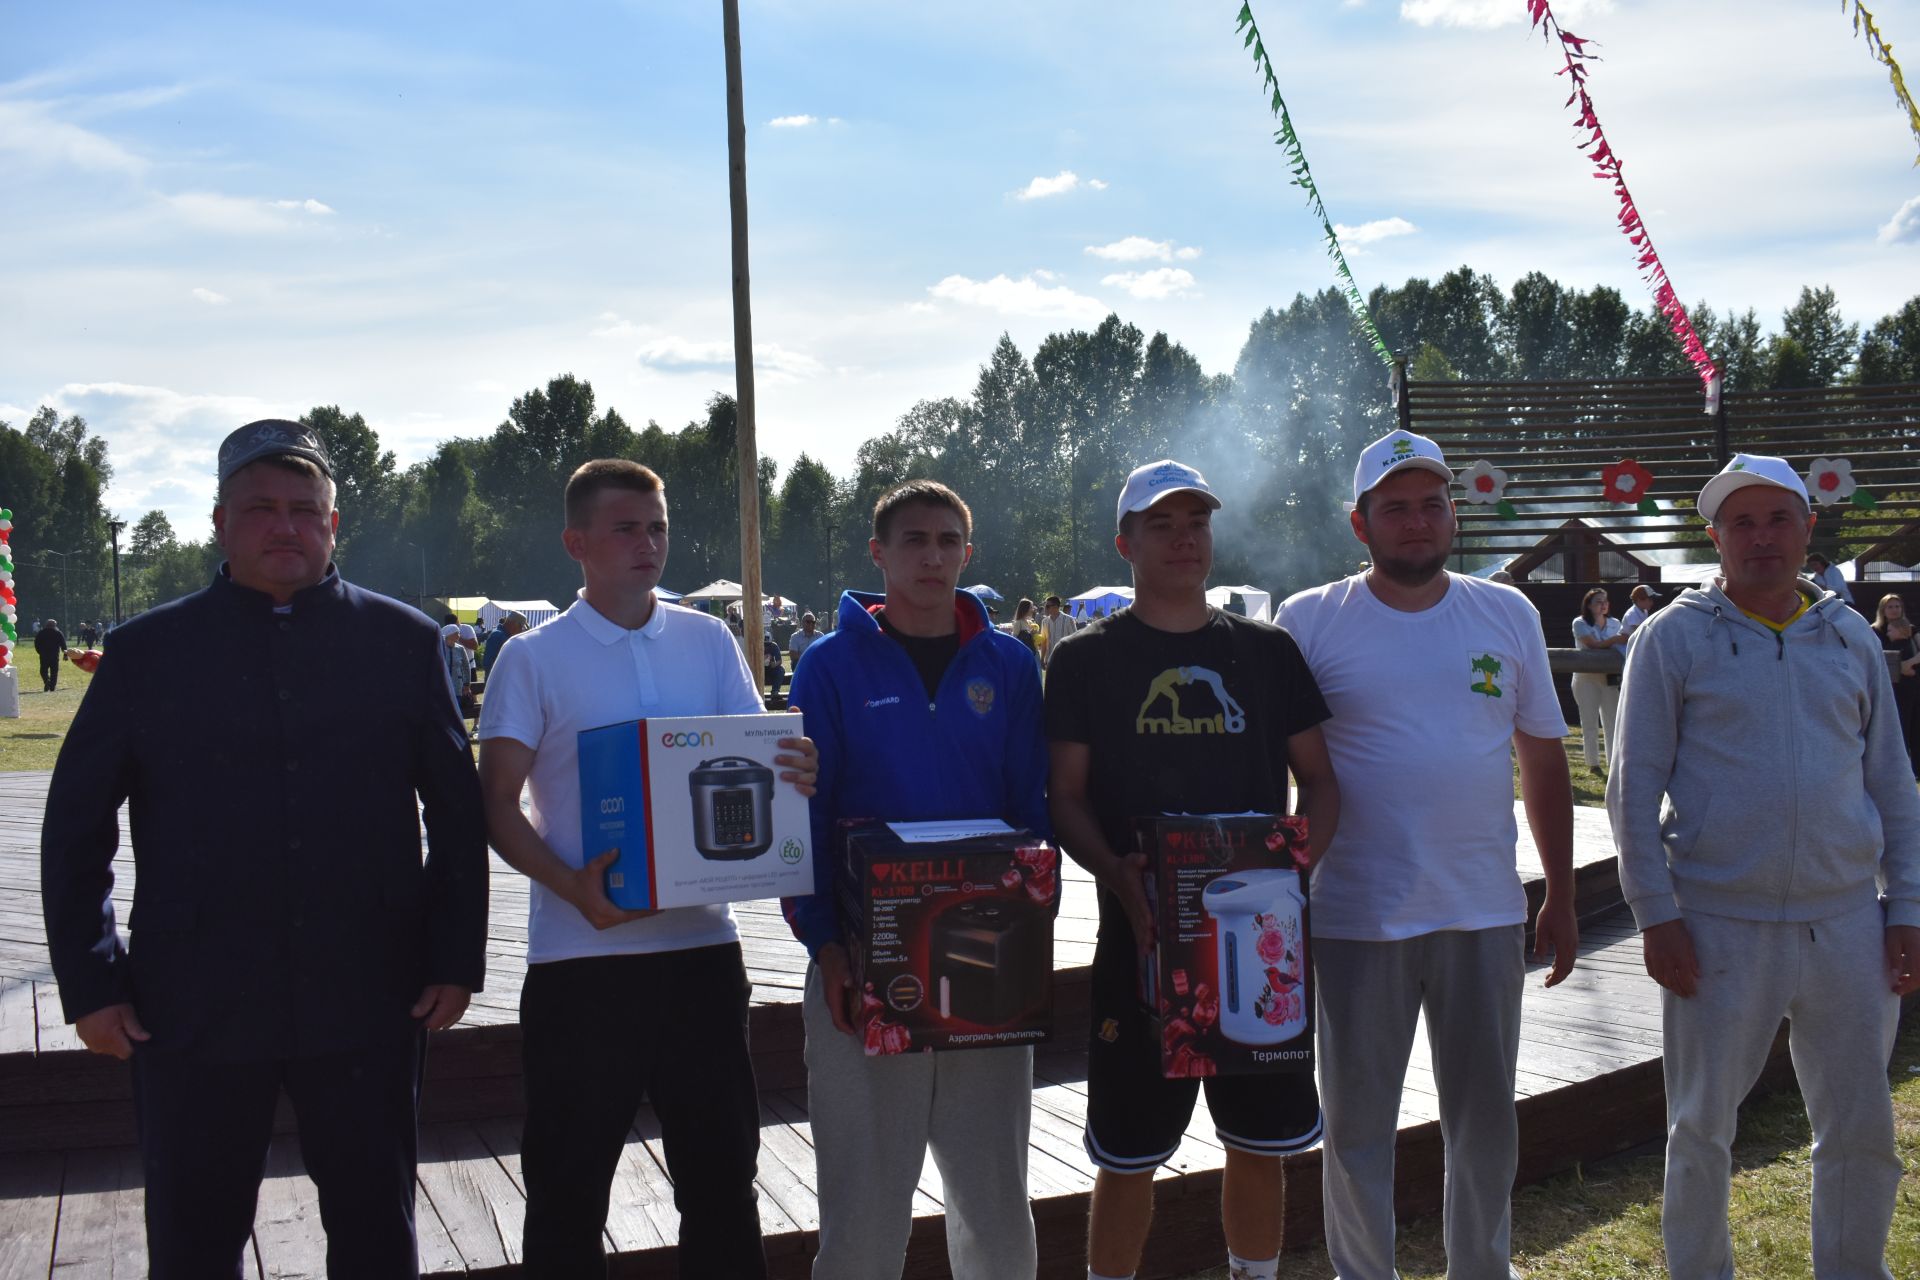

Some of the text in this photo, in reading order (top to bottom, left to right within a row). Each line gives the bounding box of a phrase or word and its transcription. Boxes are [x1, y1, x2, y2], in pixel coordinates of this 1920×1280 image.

[662, 731, 714, 747] econ
[744, 728, 795, 737] МУЛЬТИВАРКА
[600, 797, 625, 814] econ
[783, 845, 801, 859] ECO
[891, 858, 967, 882] KELLI
[948, 1030, 1046, 1044] Аэрогриль-мультипечь
[1252, 1049, 1311, 1063] Термопот
